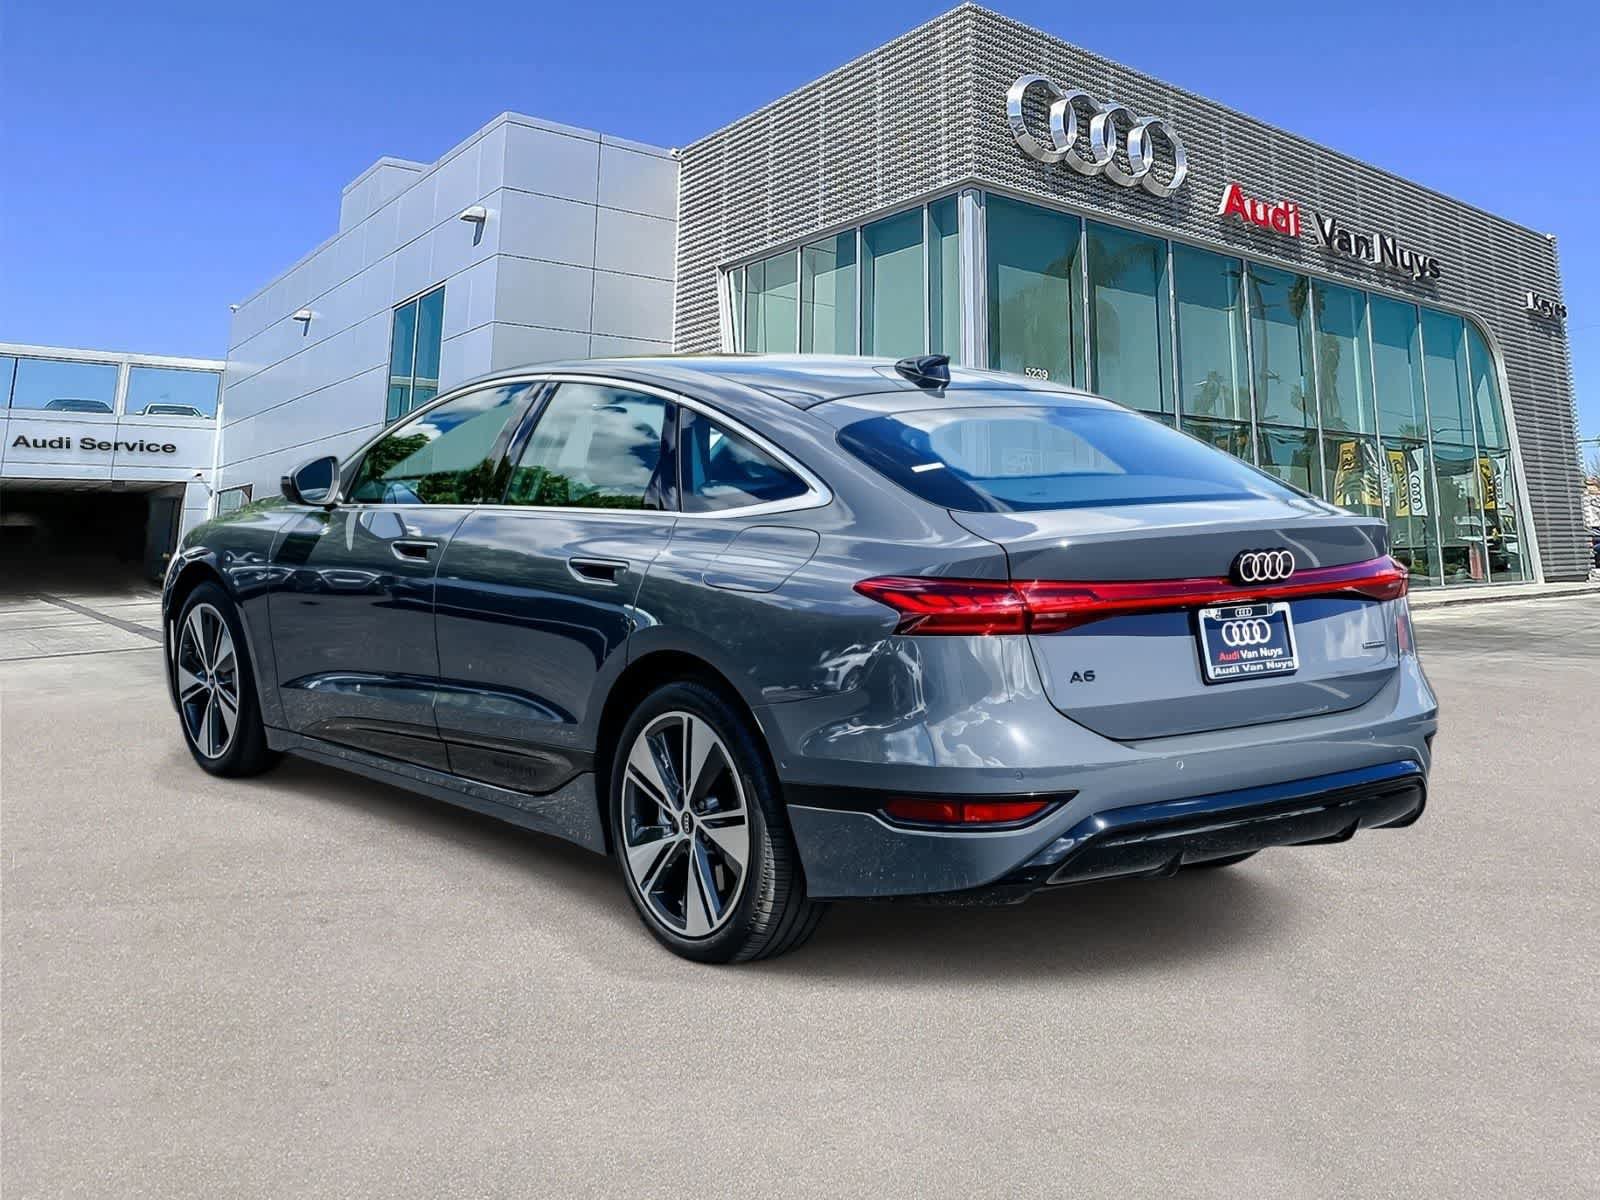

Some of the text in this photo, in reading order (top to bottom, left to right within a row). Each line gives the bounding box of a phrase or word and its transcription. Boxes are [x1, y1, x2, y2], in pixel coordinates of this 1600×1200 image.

[1217, 183, 1441, 281] Audi Van Nuys
[12, 434, 177, 454] Audi Service
[1219, 647, 1283, 661] Audi Van Nuys
[1215, 660, 1294, 675] Audi Van Nuys
[1070, 670, 1096, 684] A6
